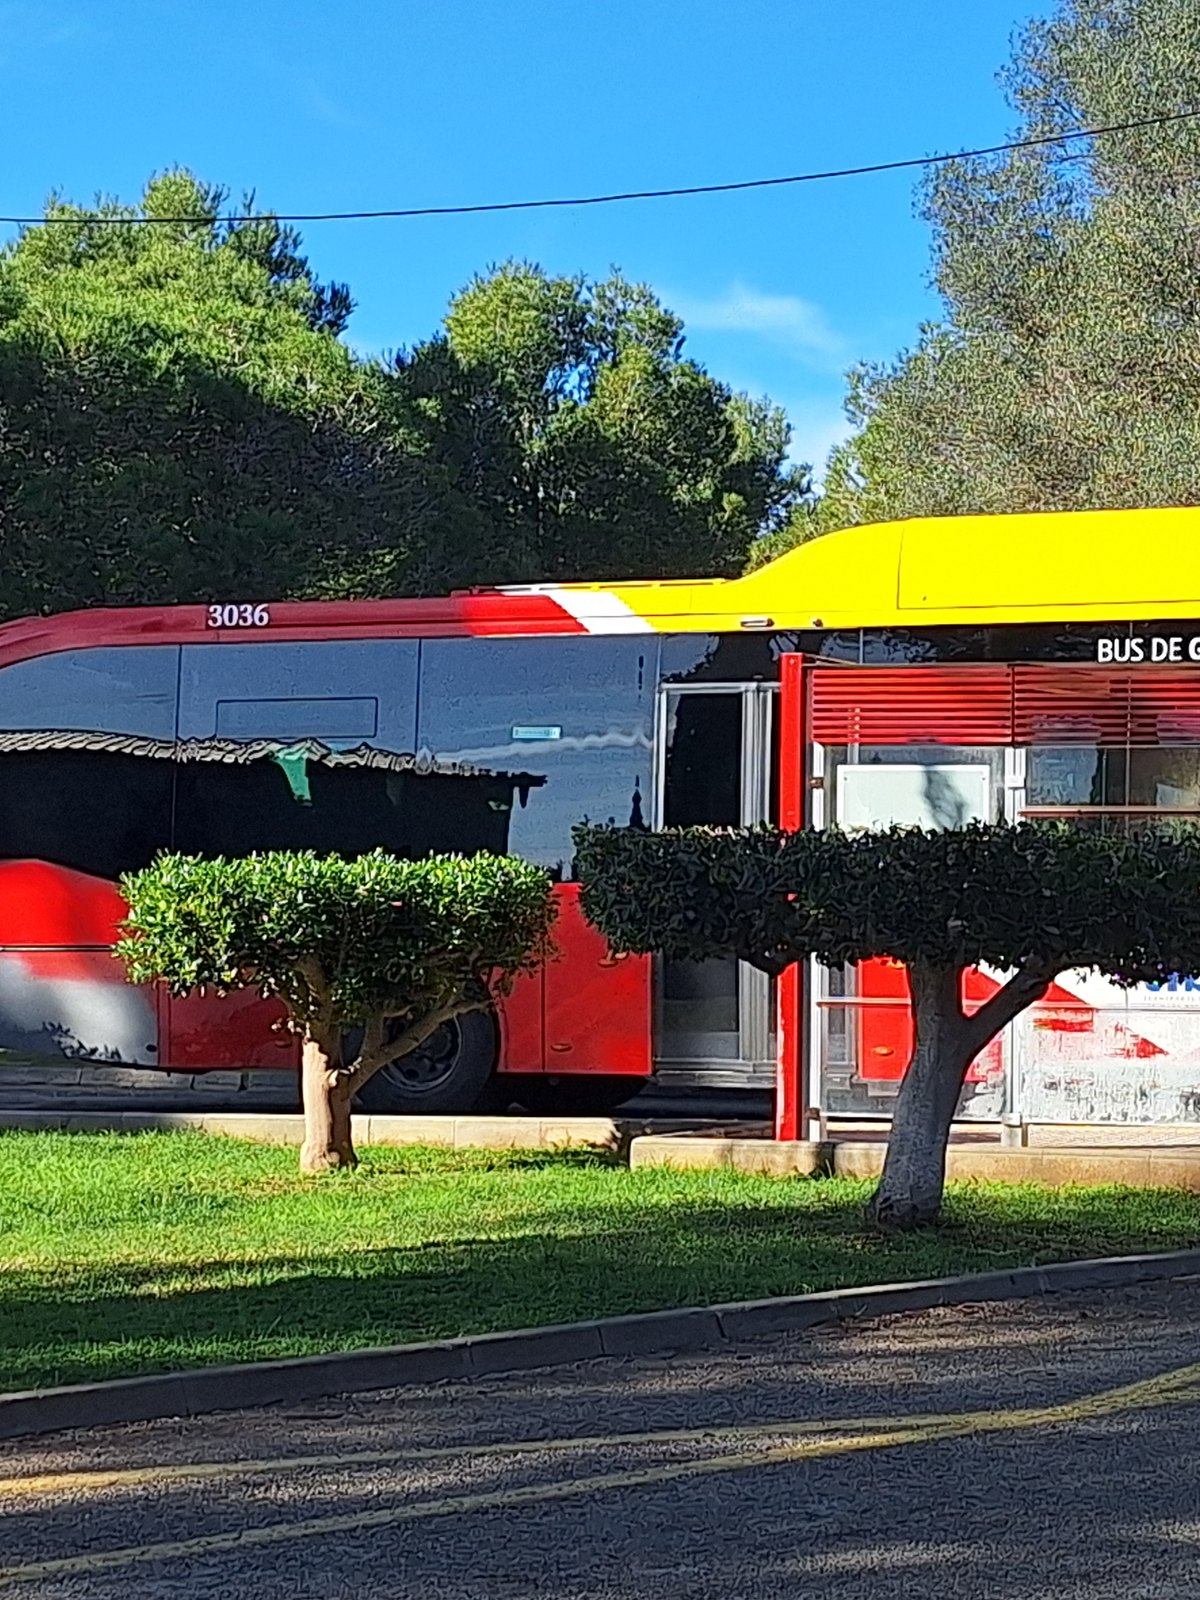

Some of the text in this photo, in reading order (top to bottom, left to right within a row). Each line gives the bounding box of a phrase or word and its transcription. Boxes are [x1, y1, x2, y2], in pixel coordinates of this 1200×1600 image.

[207, 603, 269, 627] 3036
[1097, 638, 1144, 662] BUS
[1151, 637, 1182, 662] DE
